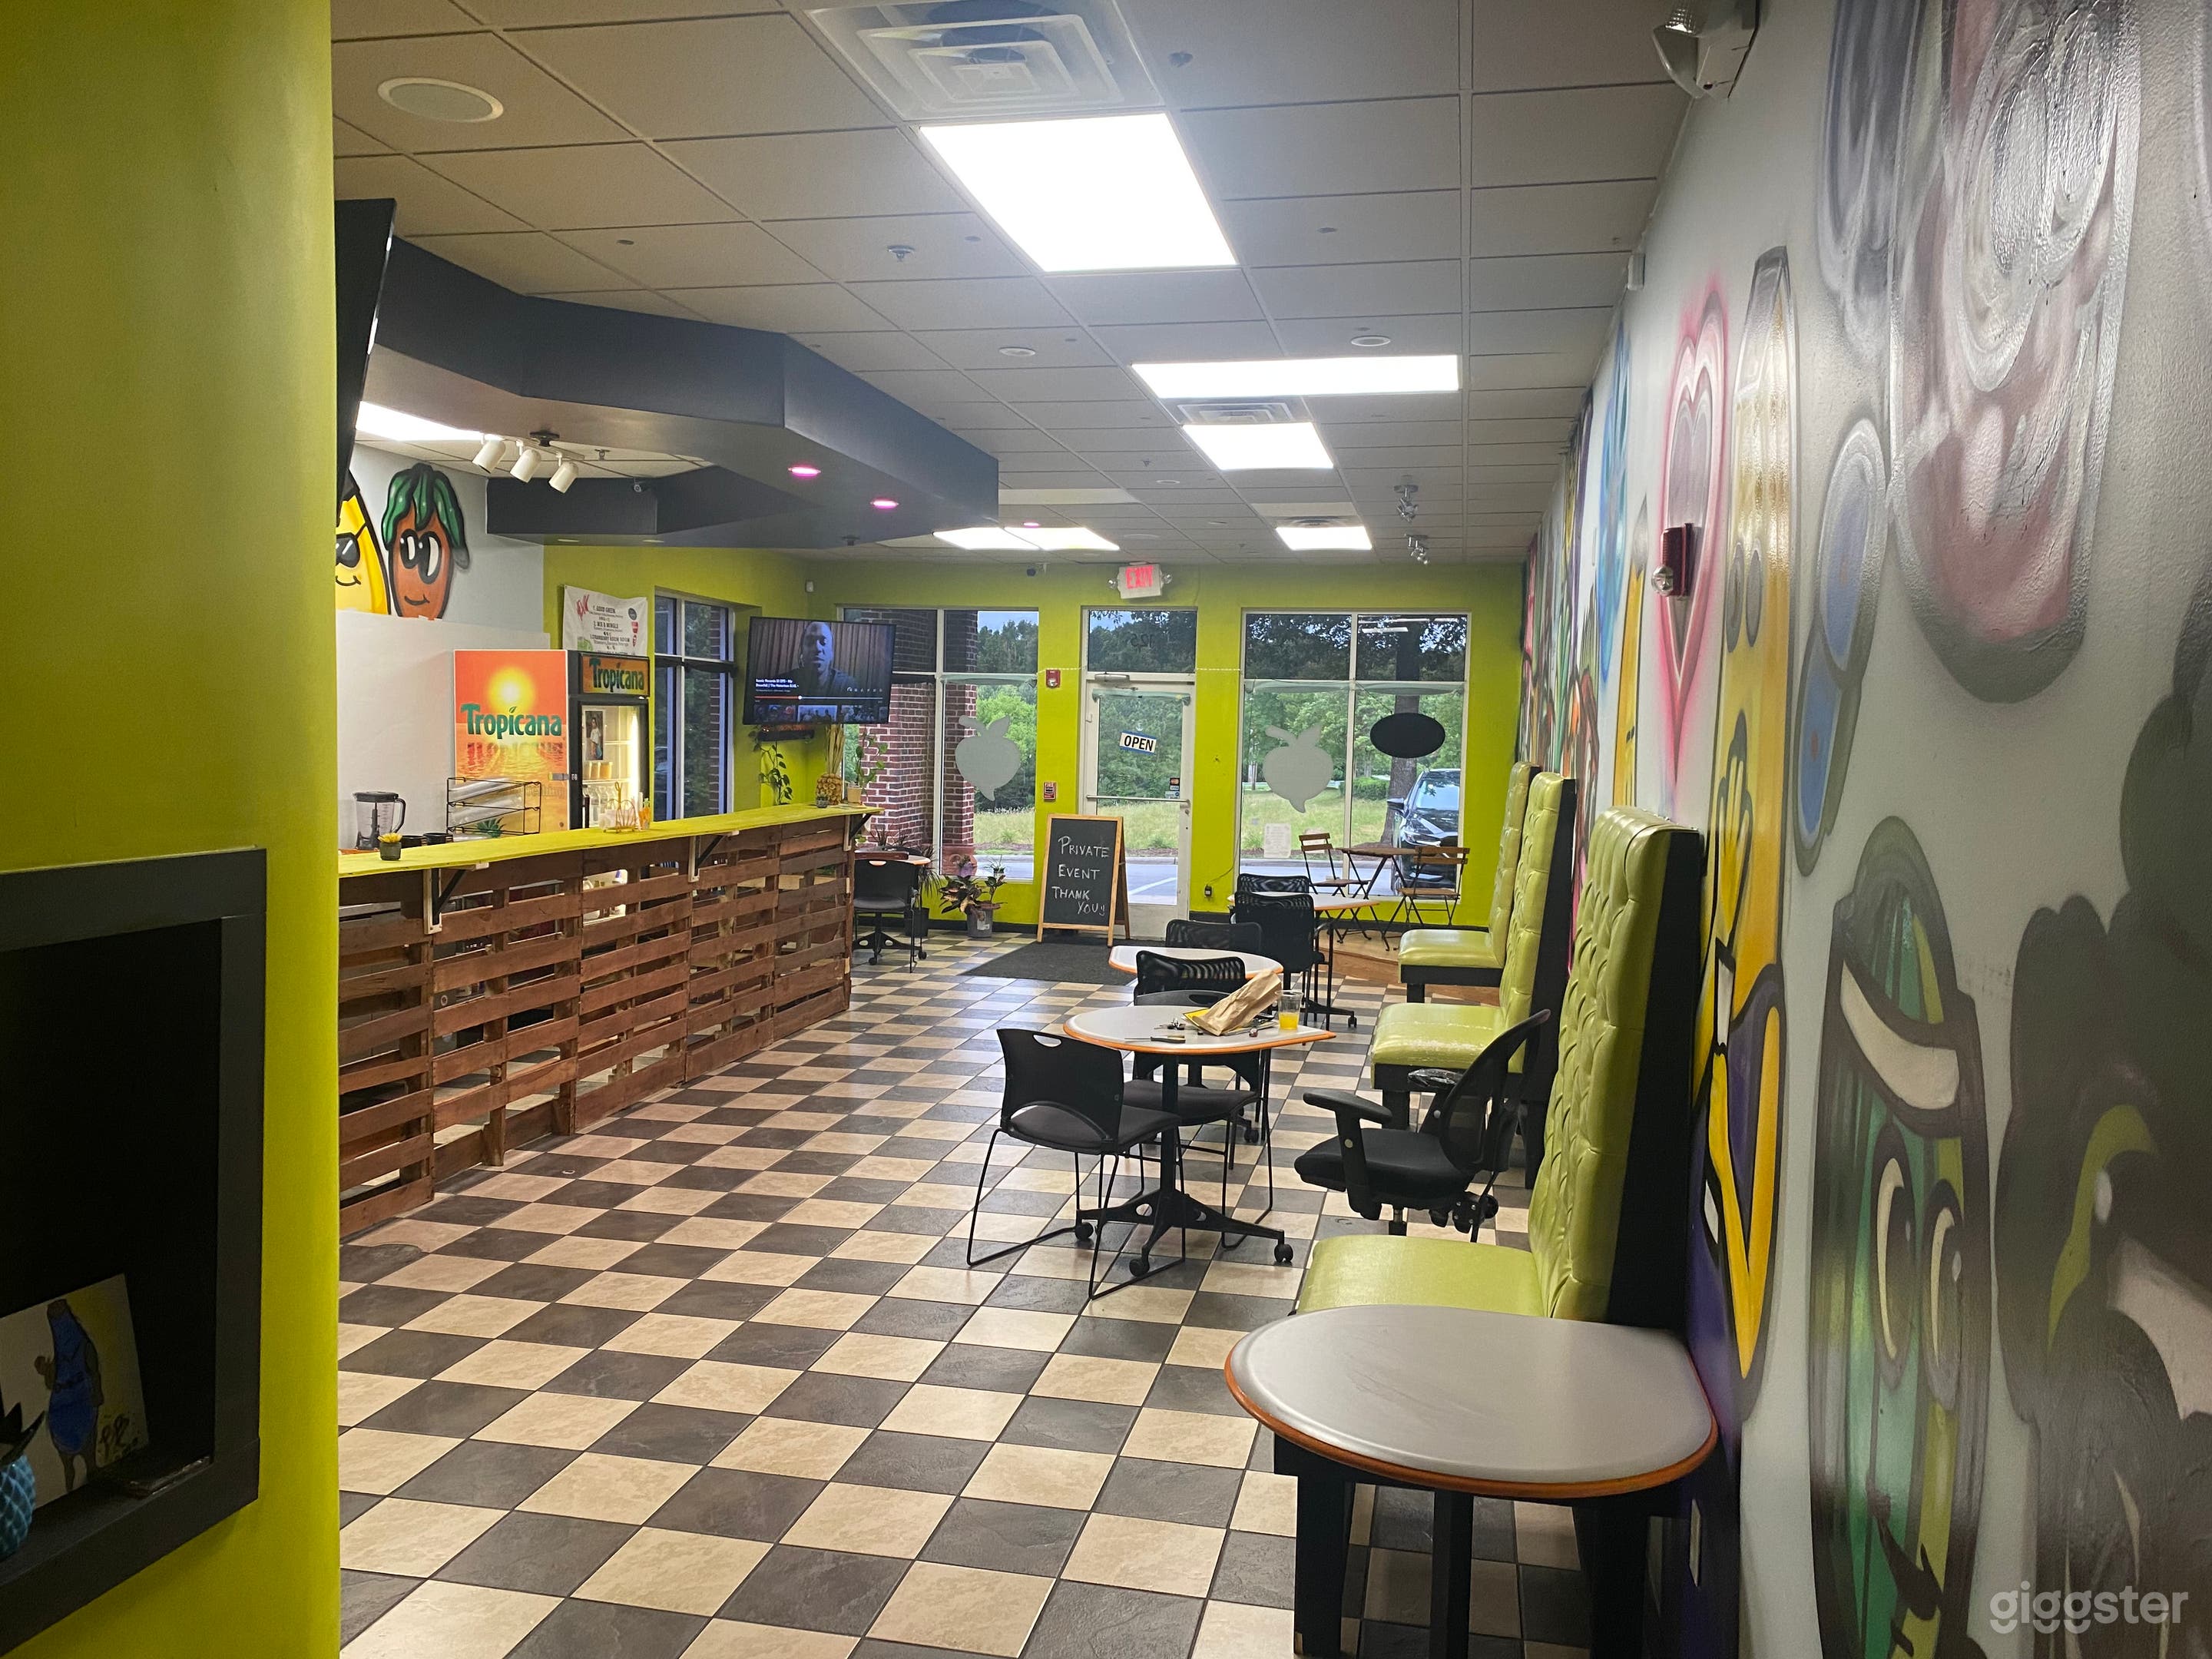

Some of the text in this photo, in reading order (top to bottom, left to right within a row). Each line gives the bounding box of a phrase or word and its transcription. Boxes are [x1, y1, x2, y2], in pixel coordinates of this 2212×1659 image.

[1126, 565, 1154, 589] EXIT
[589, 657, 644, 692] Tropicana
[460, 703, 562, 740] Tropicana
[1124, 735, 1154, 751] OPEN
[1058, 836, 1110, 858] PRIVATE
[1058, 864, 1101, 880] EVENT
[1051, 886, 1090, 901] THANK
